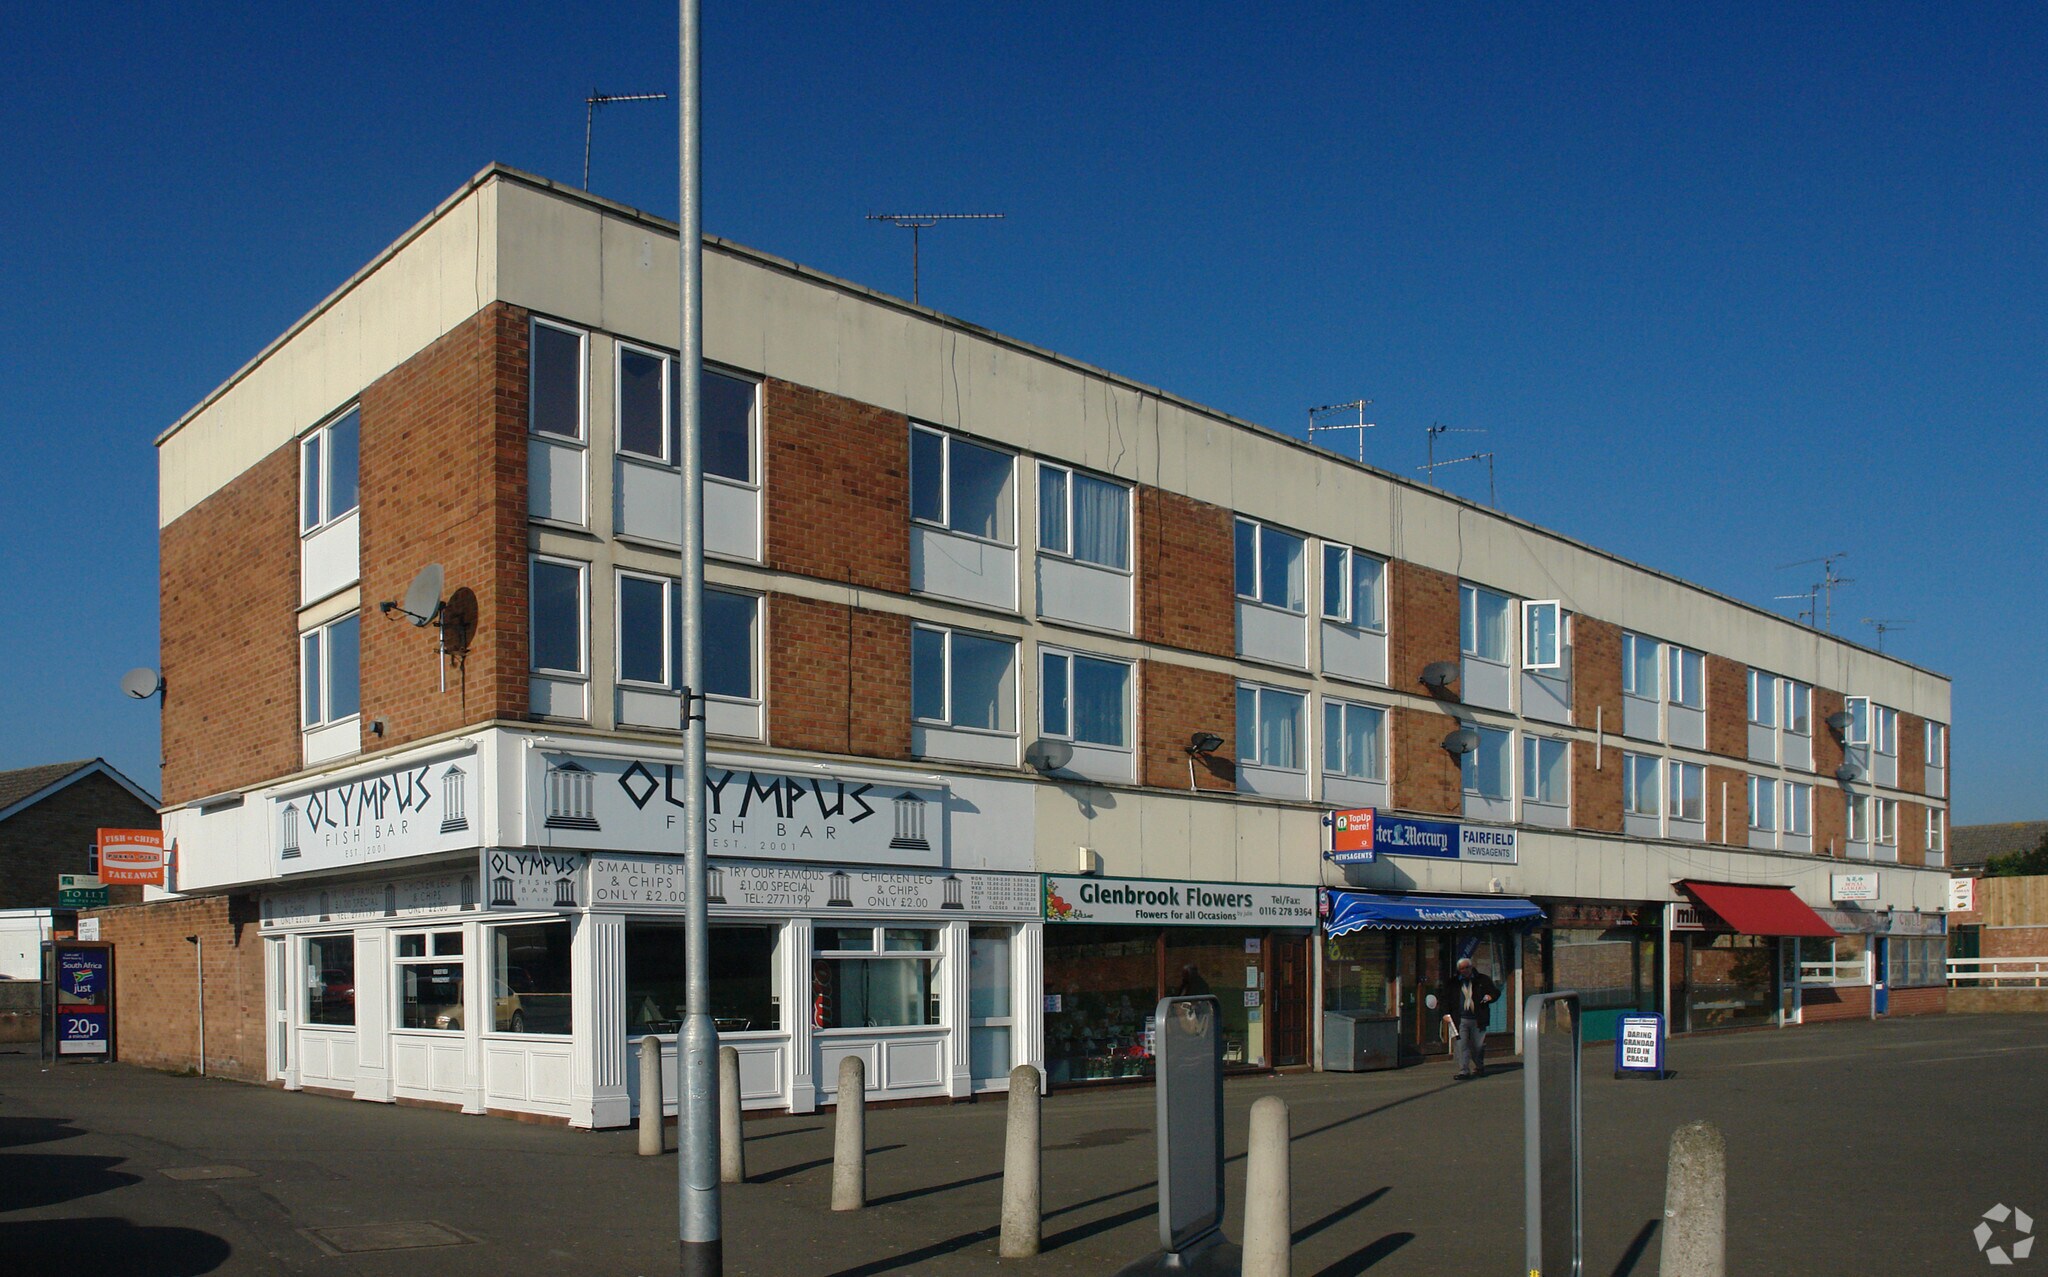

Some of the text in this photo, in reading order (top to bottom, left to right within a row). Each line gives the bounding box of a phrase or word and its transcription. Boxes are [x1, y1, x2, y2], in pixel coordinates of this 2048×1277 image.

[617, 760, 876, 824] OLYMPUS
[306, 765, 432, 834] OLYMPUS
[1349, 813, 1371, 825] TopUp
[667, 815, 836, 840] FSH BAR
[1350, 822, 1370, 831] here!
[105, 835, 126, 843] FISH
[134, 835, 160, 844] CHIPS
[325, 820, 408, 847] FISH BAR
[1404, 825, 1448, 852] Mercury
[1463, 830, 1514, 846] FAIRFIELD
[367, 844, 387, 855] 2001
[760, 841, 797, 851] 2001
[1335, 851, 1373, 862] NEWSAGENTS
[1467, 847, 1510, 858] NEWSAGENTS
[491, 854, 575, 876] OLYMPUS
[598, 861, 685, 876] SMALL FISH
[108, 870, 159, 879] TAKEAWAY
[729, 866, 824, 881] TRY OUR FAMOUS
[861, 872, 933, 885] CHICKEN LEG
[611, 876, 673, 889] & CHIPS
[739, 880, 815, 893] £1.00 SPECIAL
[65, 890, 81, 898] TO
[421, 890, 441, 902] CHIPS
[597, 888, 686, 902] ONLY £2.00
[877, 885, 919, 896] & CHIPS
[1079, 883, 1254, 908] Glenbrook Flowers
[744, 893, 811, 905] TEL: 2771199
[867, 896, 928, 908] ONLY £2.00
[1271, 894, 1301, 906] Tel/Fax:
[408, 904, 425, 915] ONLY
[1135, 909, 1237, 921] Flowers for all Occasions
[1259, 906, 1277, 916] 0116
[1278, 906, 1293, 916] 278
[1294, 907, 1313, 917] 9364
[73, 984, 92, 994] just
[68, 1018, 99, 1036] 20p
[1627, 1031, 1652, 1039] DARING
[1623, 1039, 1655, 1047] GRANDAD
[1626, 1055, 1649, 1063] CRASH
